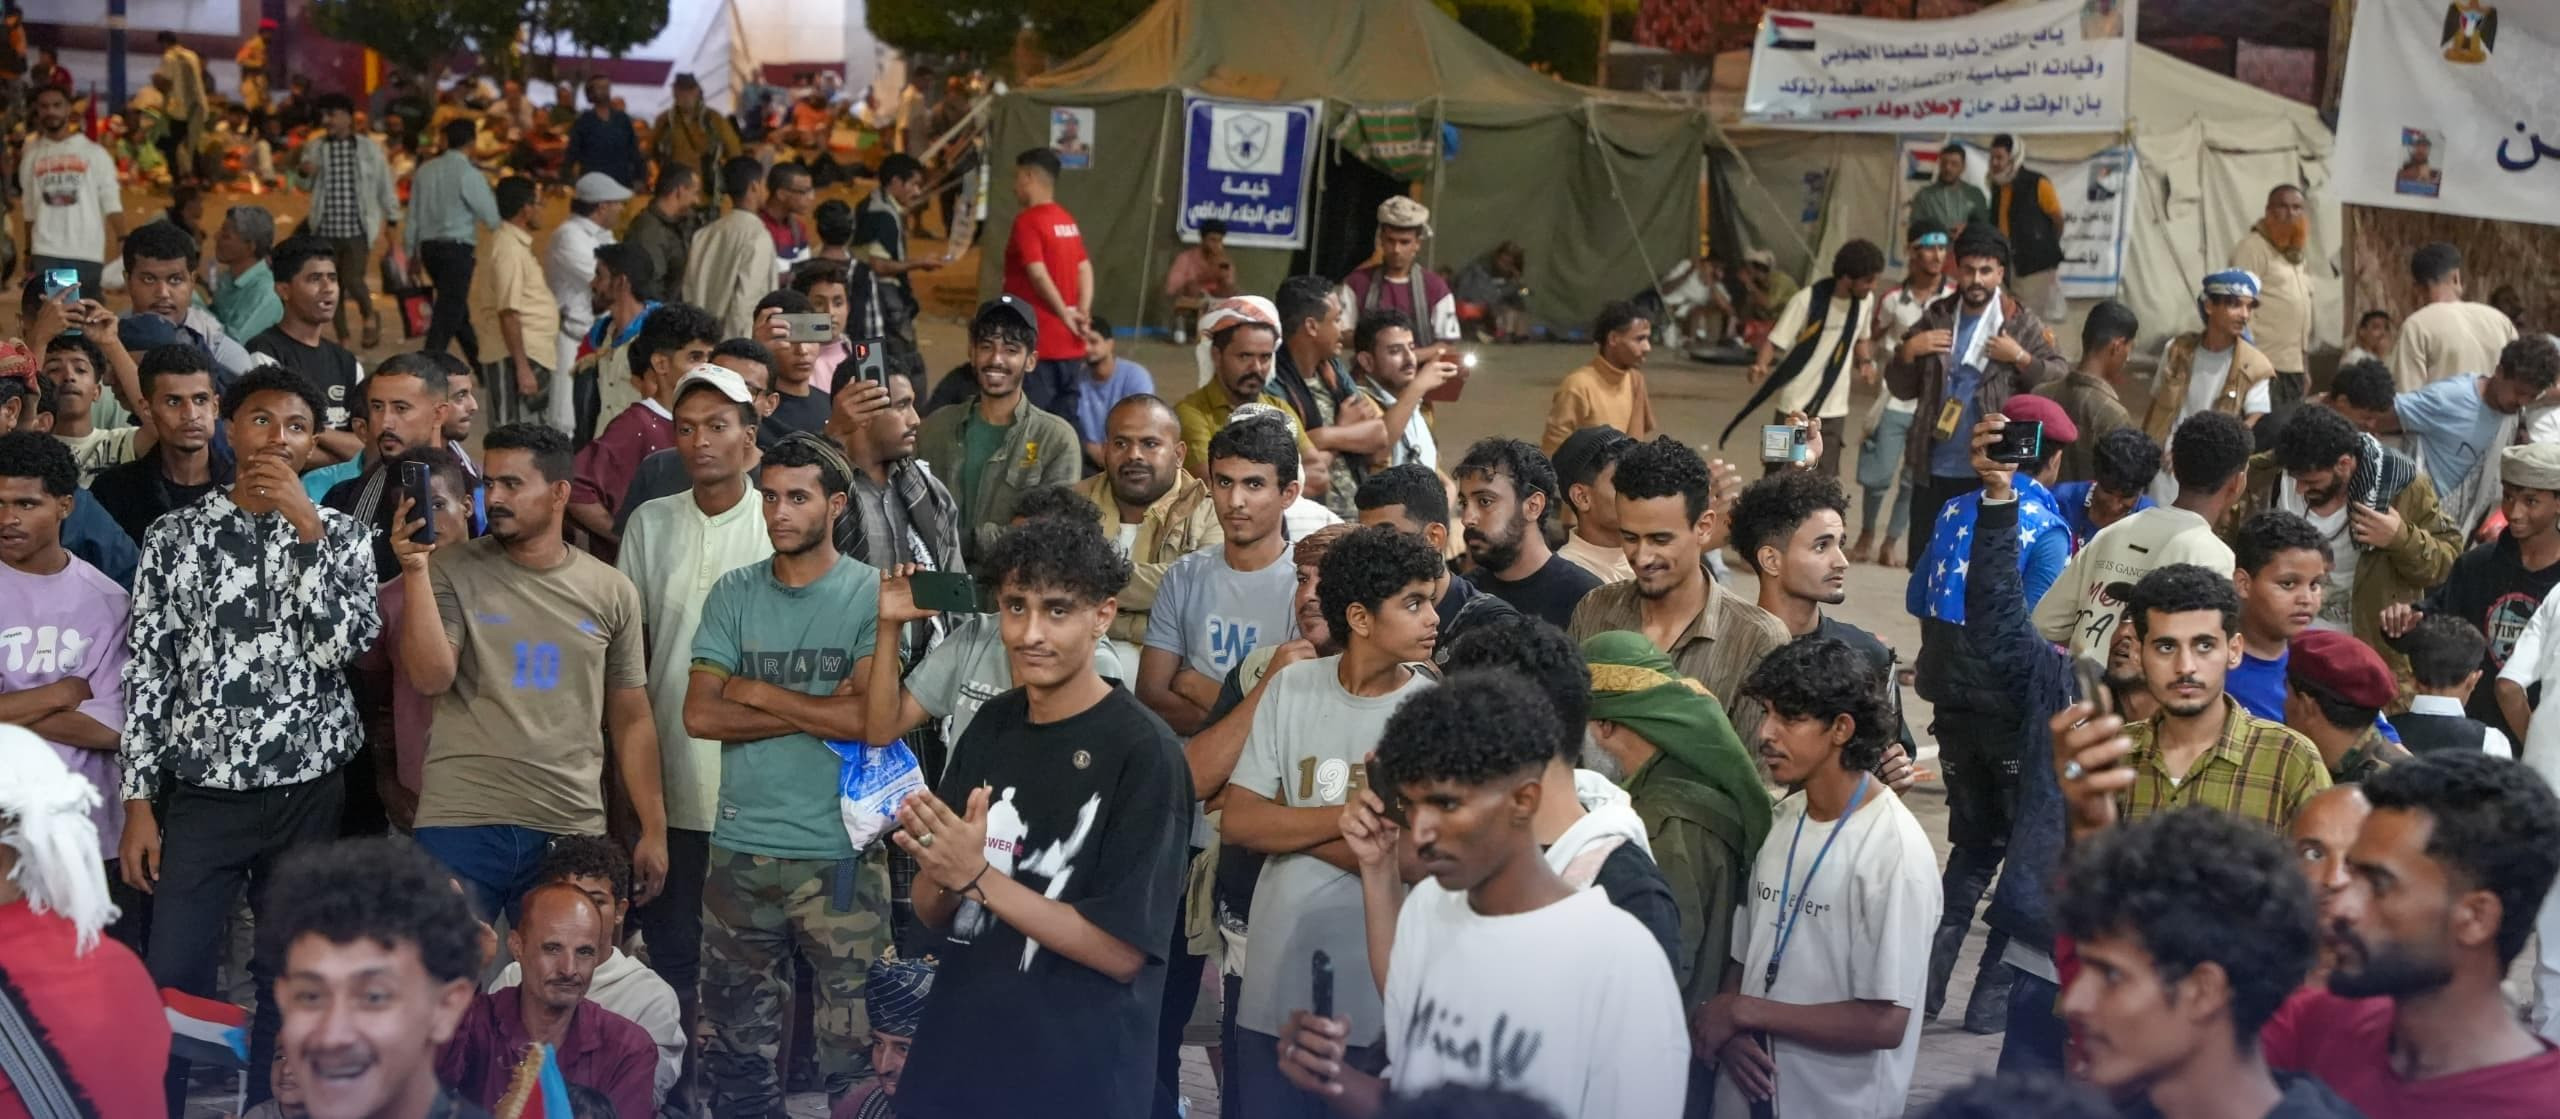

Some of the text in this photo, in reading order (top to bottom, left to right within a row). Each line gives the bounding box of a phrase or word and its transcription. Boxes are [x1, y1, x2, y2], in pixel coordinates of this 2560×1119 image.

[1821, 44, 1878, 67] الجنوبي
[1882, 42, 1928, 62] لشعبنا
[1933, 38, 1979, 60] تبارك
[1966, 60, 2038, 86] السياسية
[1964, 97, 1995, 118] حان
[1998, 93, 2021, 113] قد
[2023, 93, 2070, 116] الوقت
[1221, 176, 1270, 199] خيمة
[1264, 206, 1292, 230] نادي
[513, 641, 560, 689] 10
